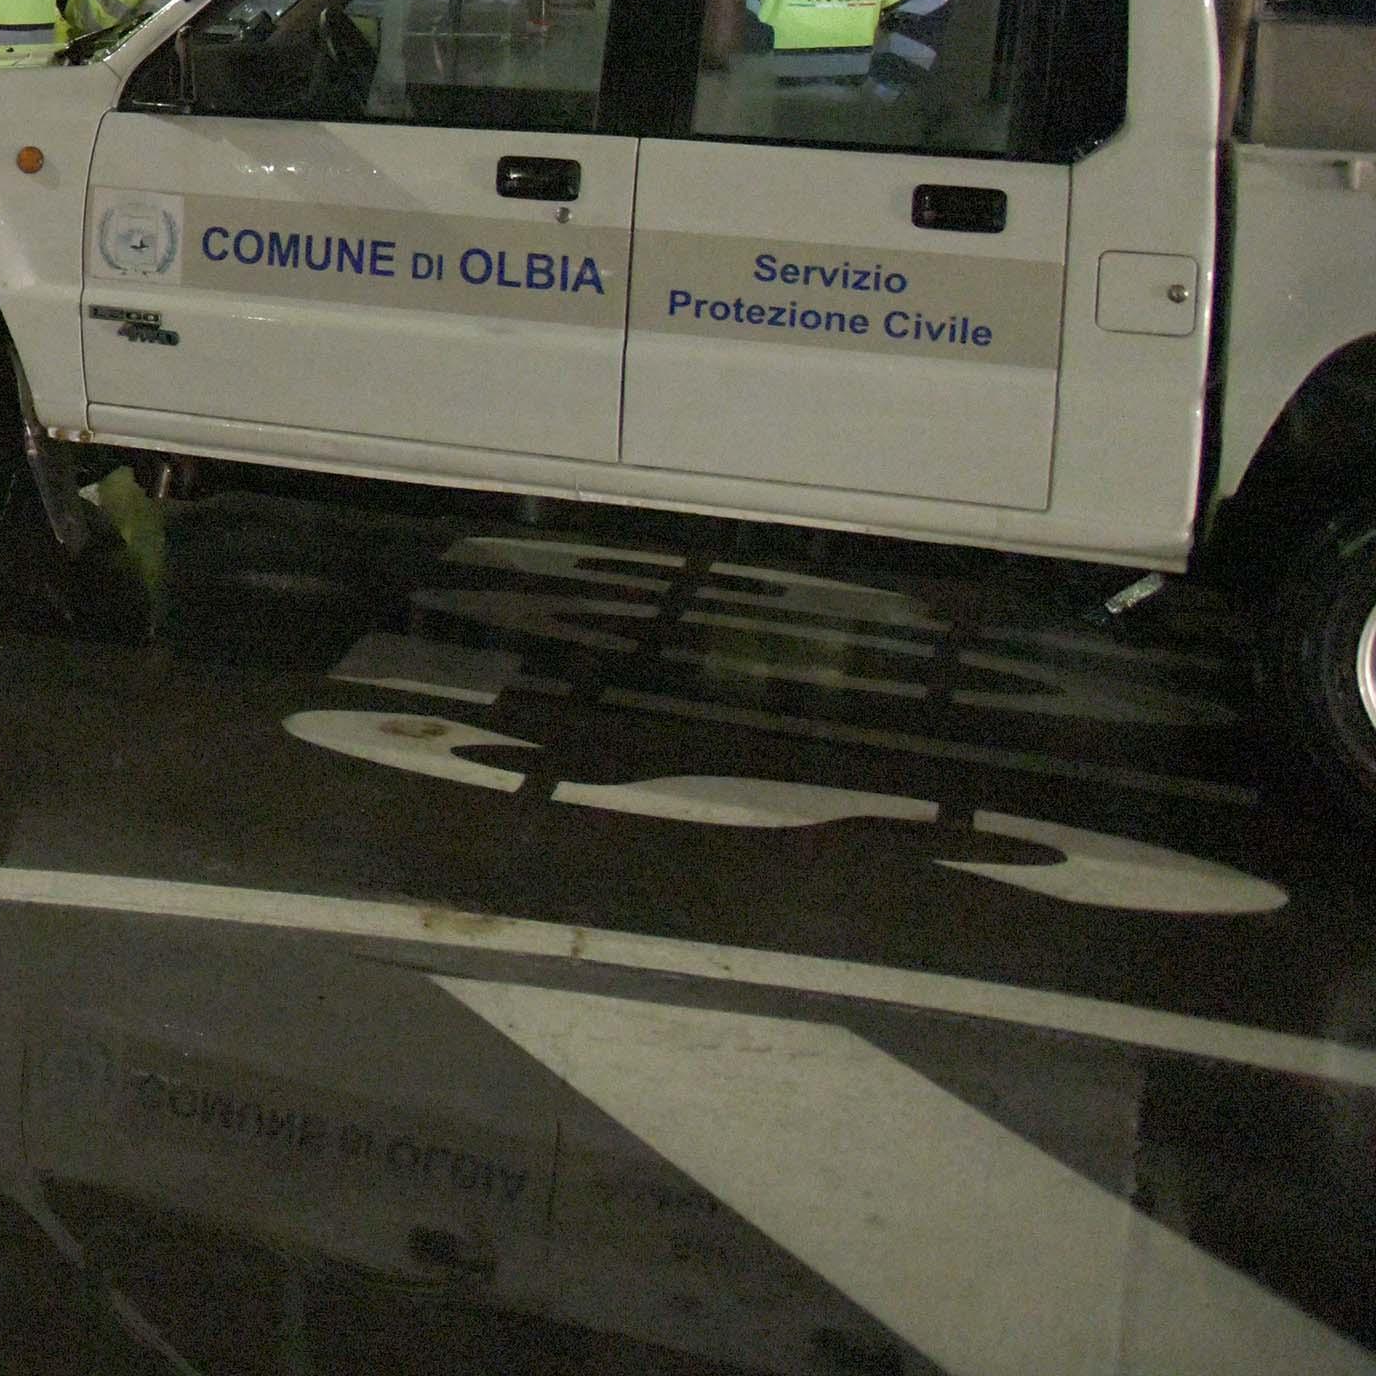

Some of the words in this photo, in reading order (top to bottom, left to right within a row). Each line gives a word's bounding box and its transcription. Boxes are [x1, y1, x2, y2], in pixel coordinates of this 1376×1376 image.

[201, 226, 396, 280] COMUNE
[411, 252, 445, 281] DI
[460, 247, 606, 296] OLBIA
[753, 254, 908, 294] Servizio
[668, 290, 870, 334] Protezione
[884, 308, 993, 348] Civile
